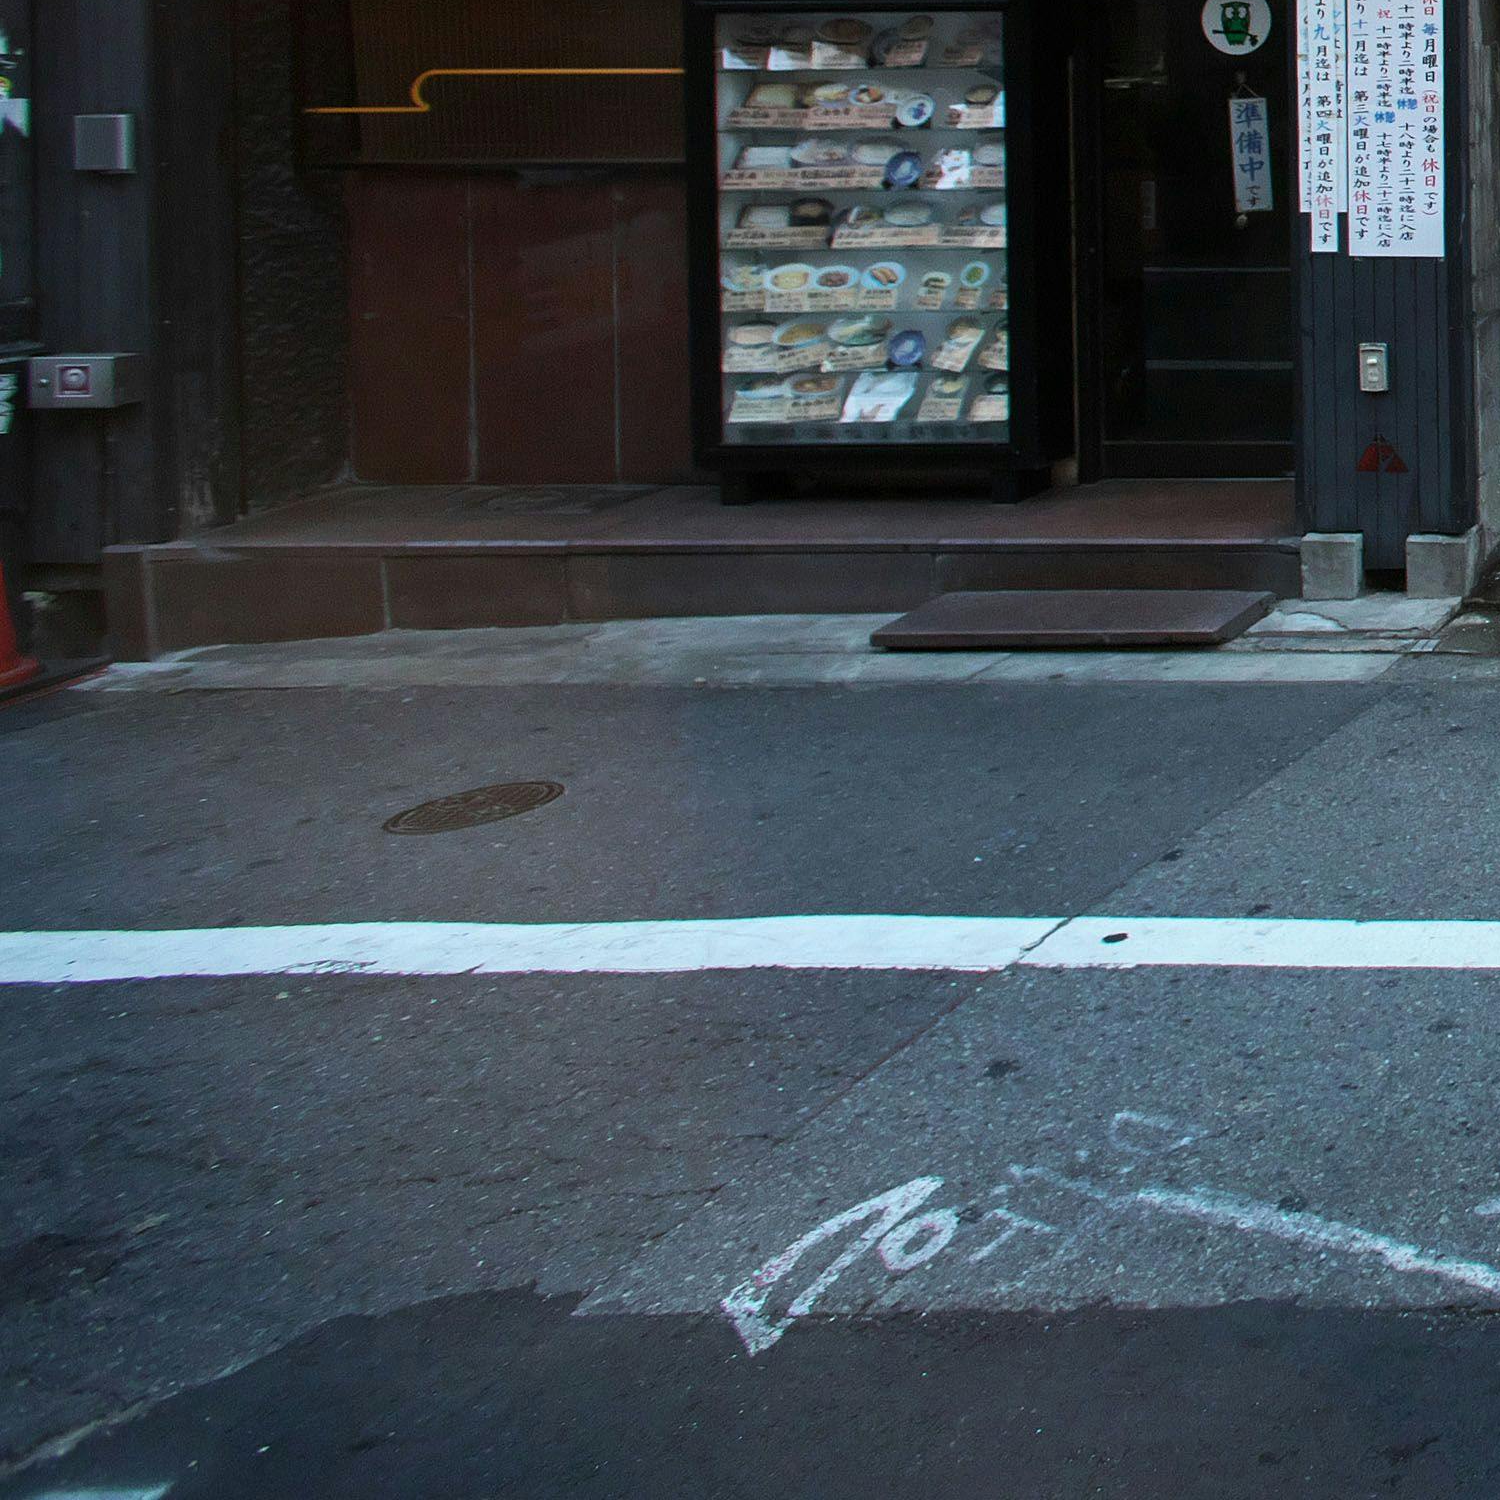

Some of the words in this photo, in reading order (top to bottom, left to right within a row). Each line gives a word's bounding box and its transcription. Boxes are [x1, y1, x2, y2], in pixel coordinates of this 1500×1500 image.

[1234, 102, 1265, 208] 準備中です
